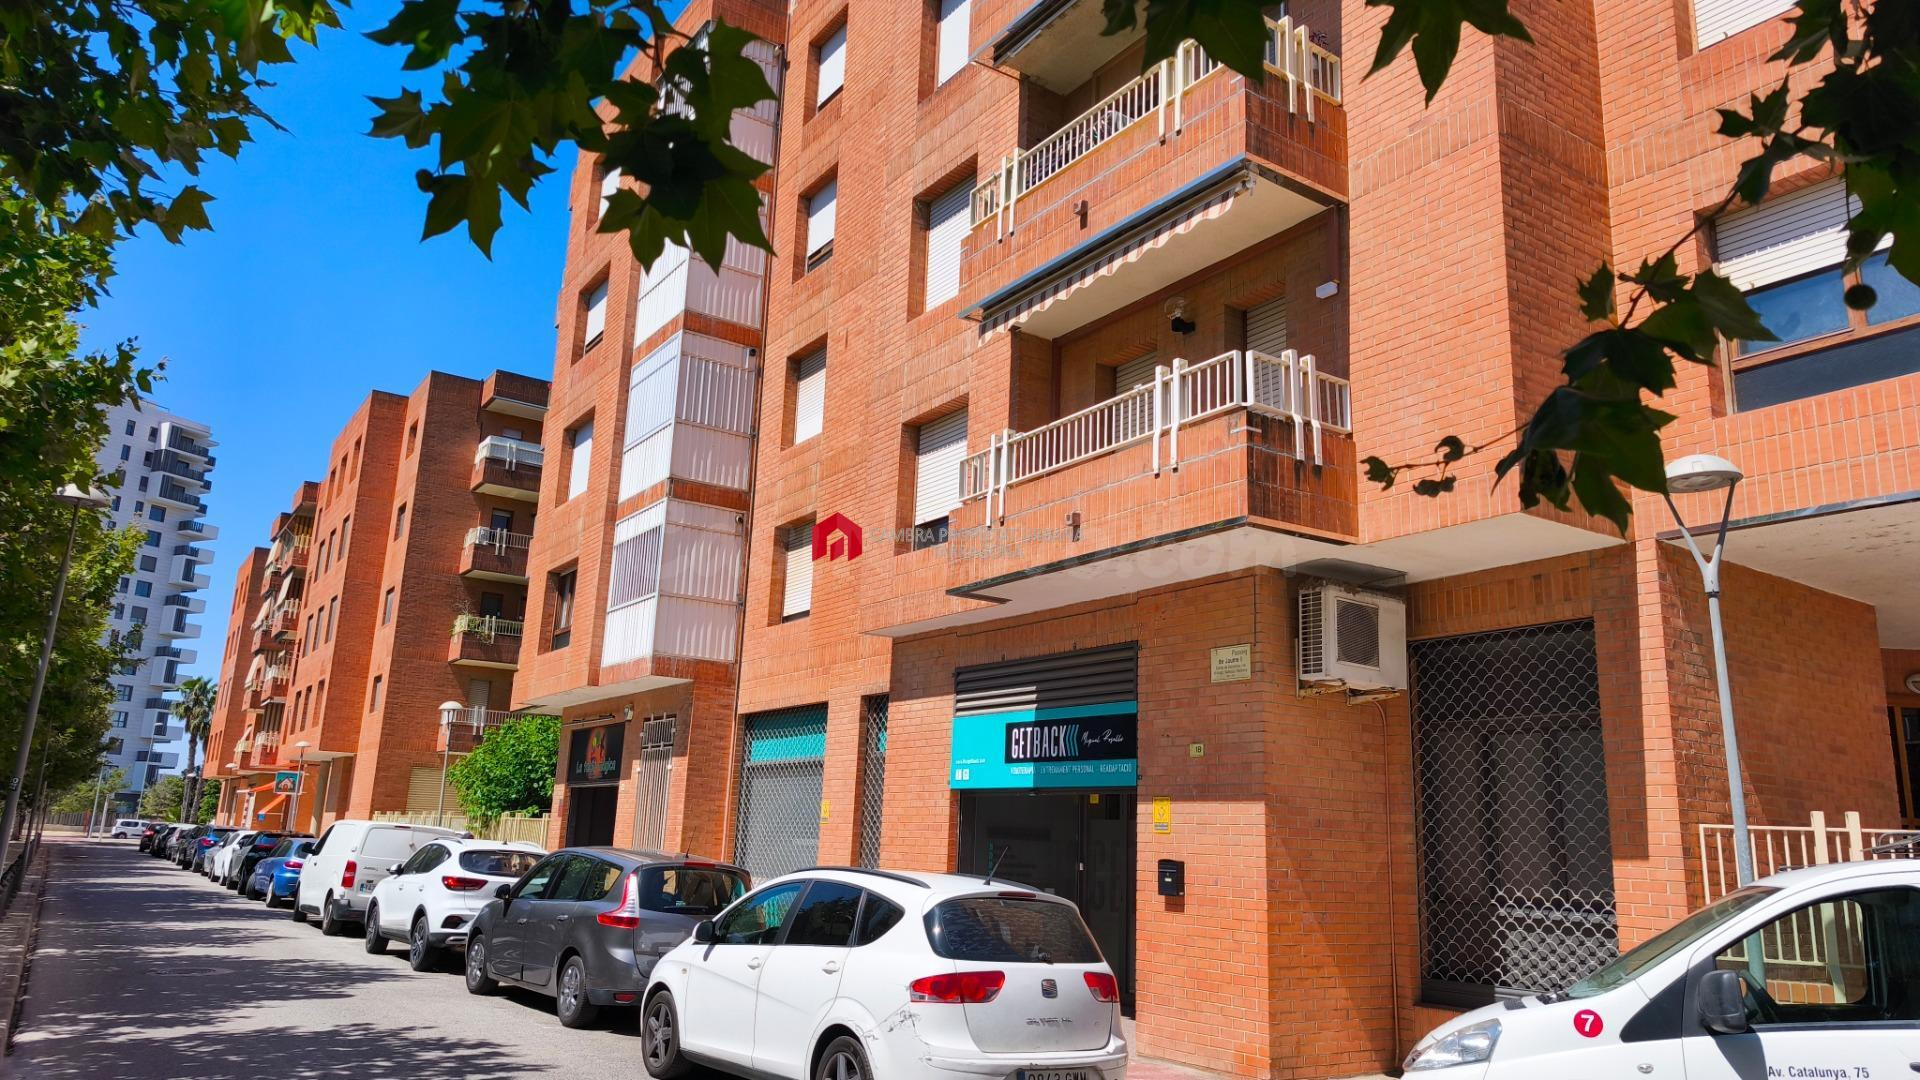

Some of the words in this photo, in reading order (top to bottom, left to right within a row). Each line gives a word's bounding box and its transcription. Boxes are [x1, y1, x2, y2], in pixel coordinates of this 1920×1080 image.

[1011, 724, 1067, 759] GETBACK
[1581, 1014, 1595, 1032] 7
[1768, 1066, 1785, 1077] Av.
[1854, 1067, 1870, 1079] 75
